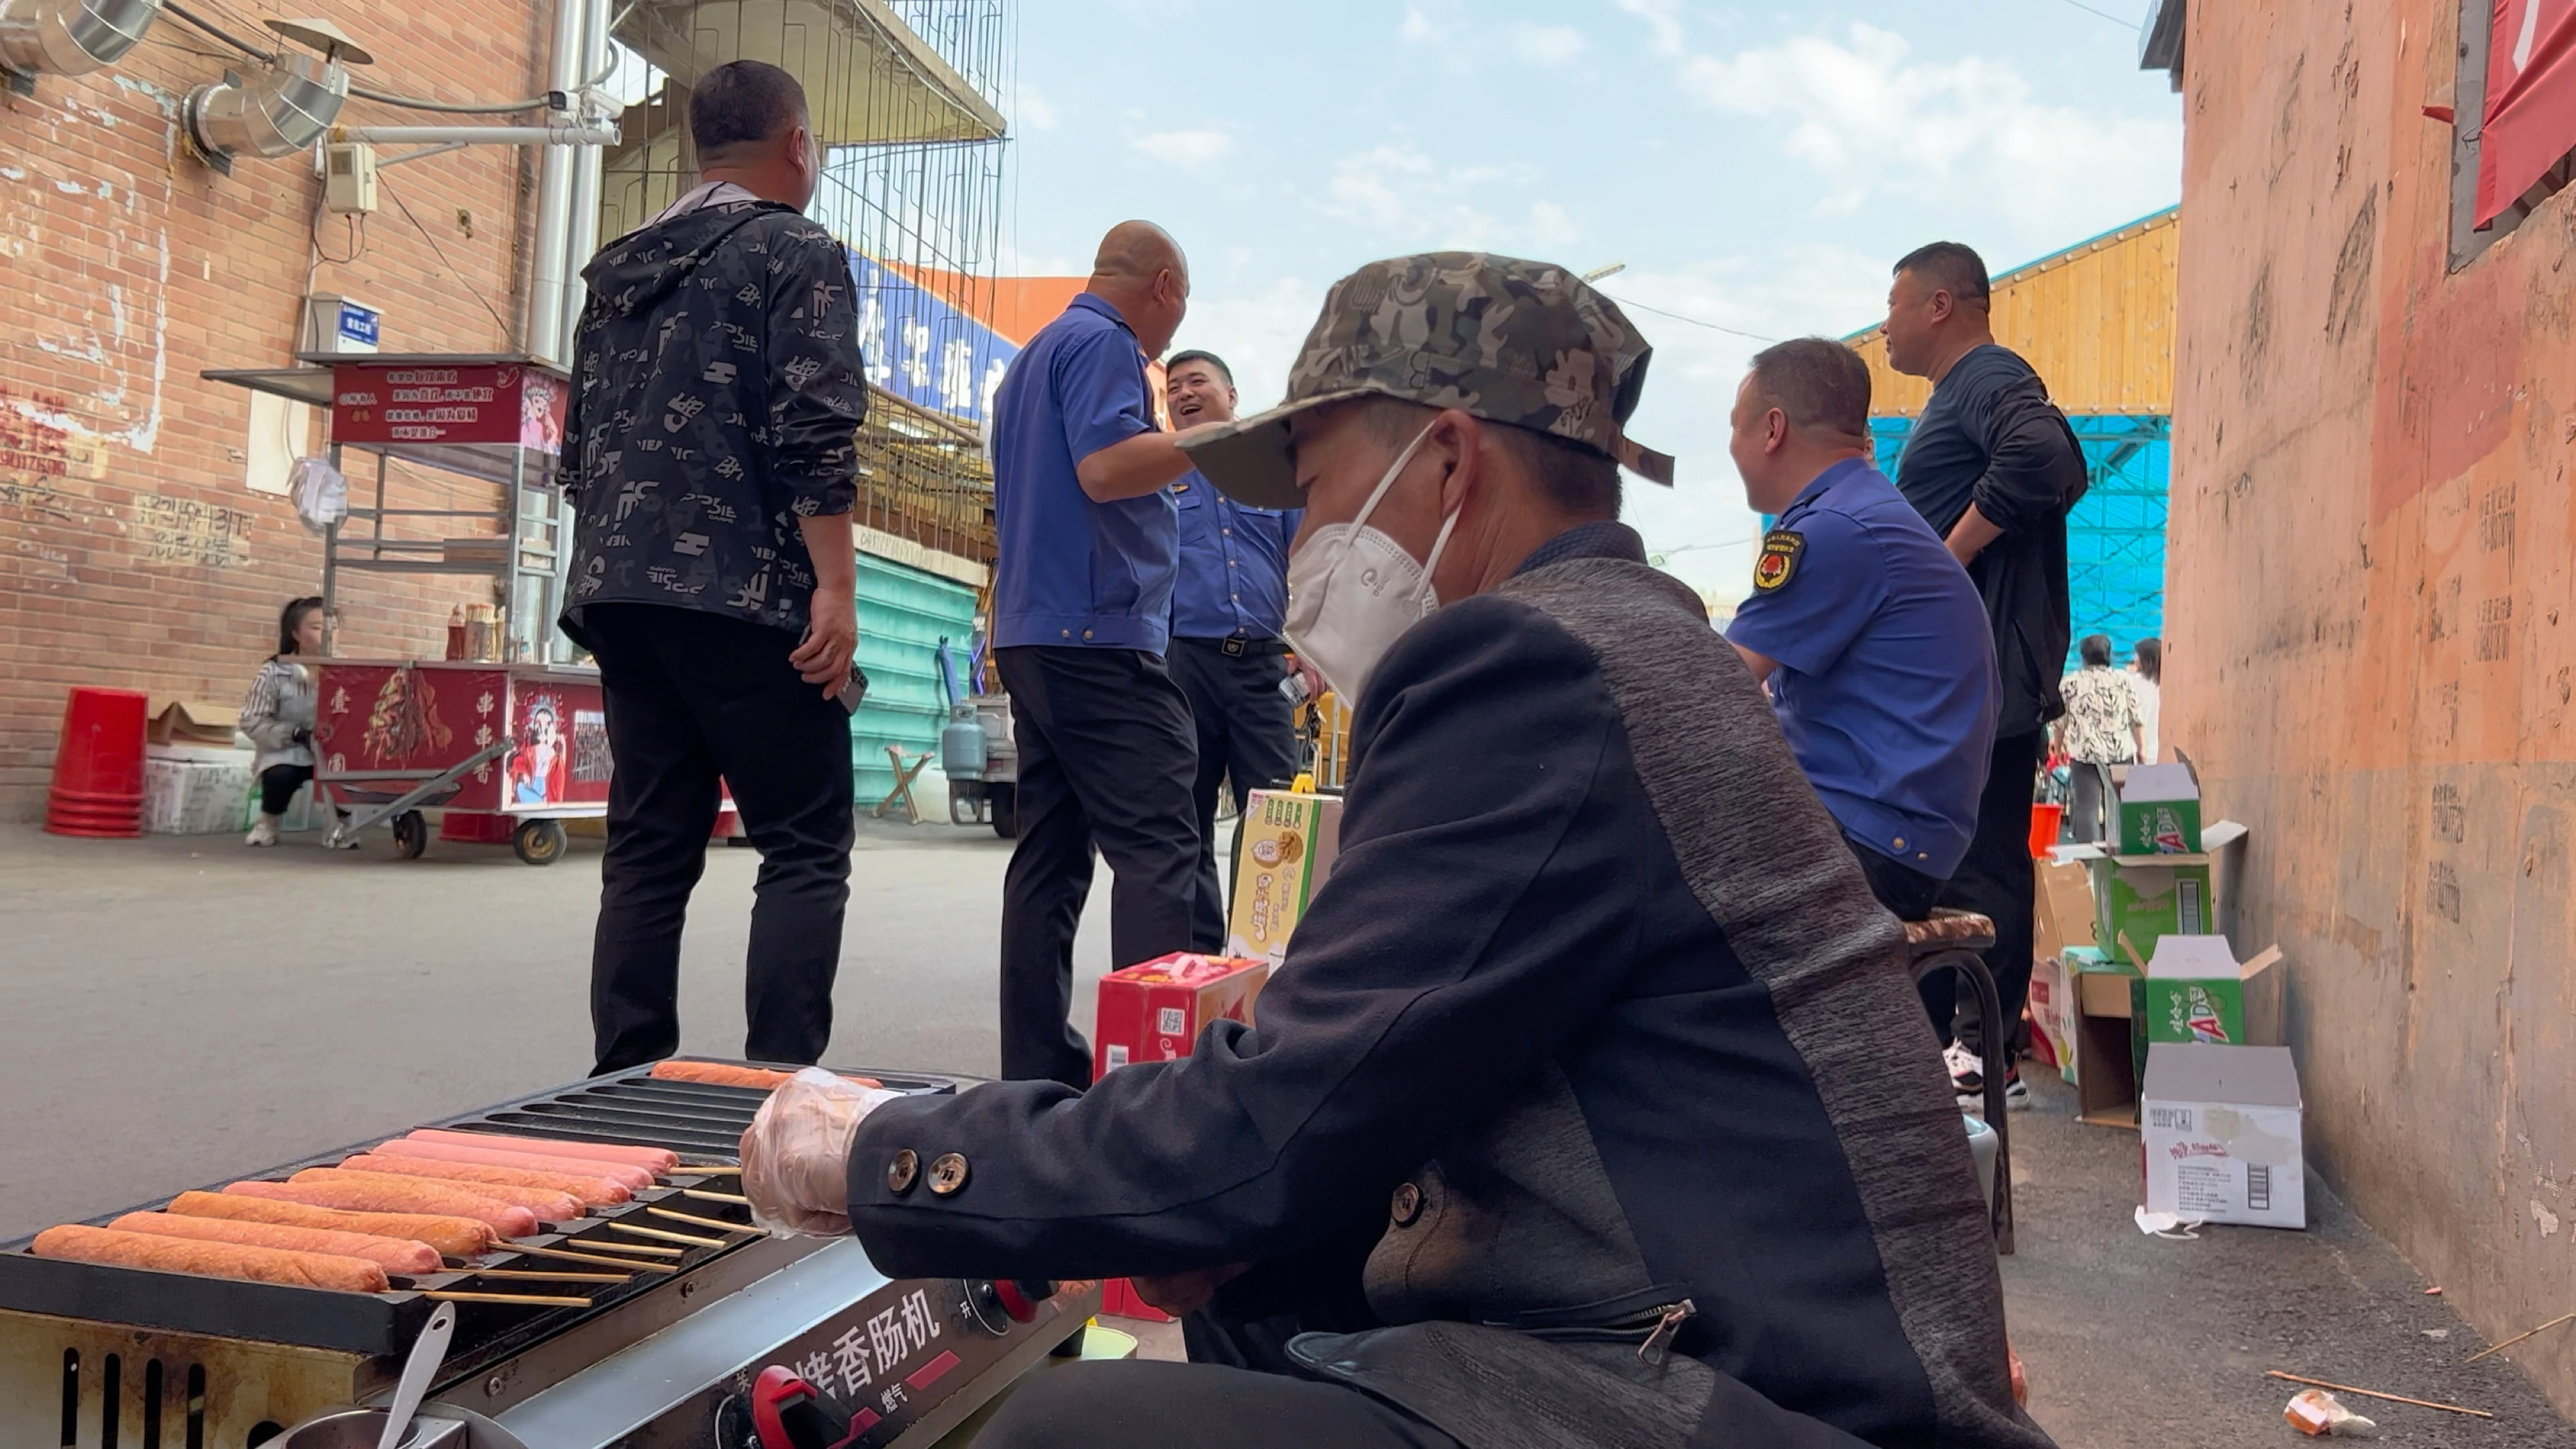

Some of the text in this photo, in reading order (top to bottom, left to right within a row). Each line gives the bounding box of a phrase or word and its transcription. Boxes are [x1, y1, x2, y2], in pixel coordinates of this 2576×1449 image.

[959, 1301, 971, 1320] 开
[796, 1288, 941, 1400] 烤香肠机
